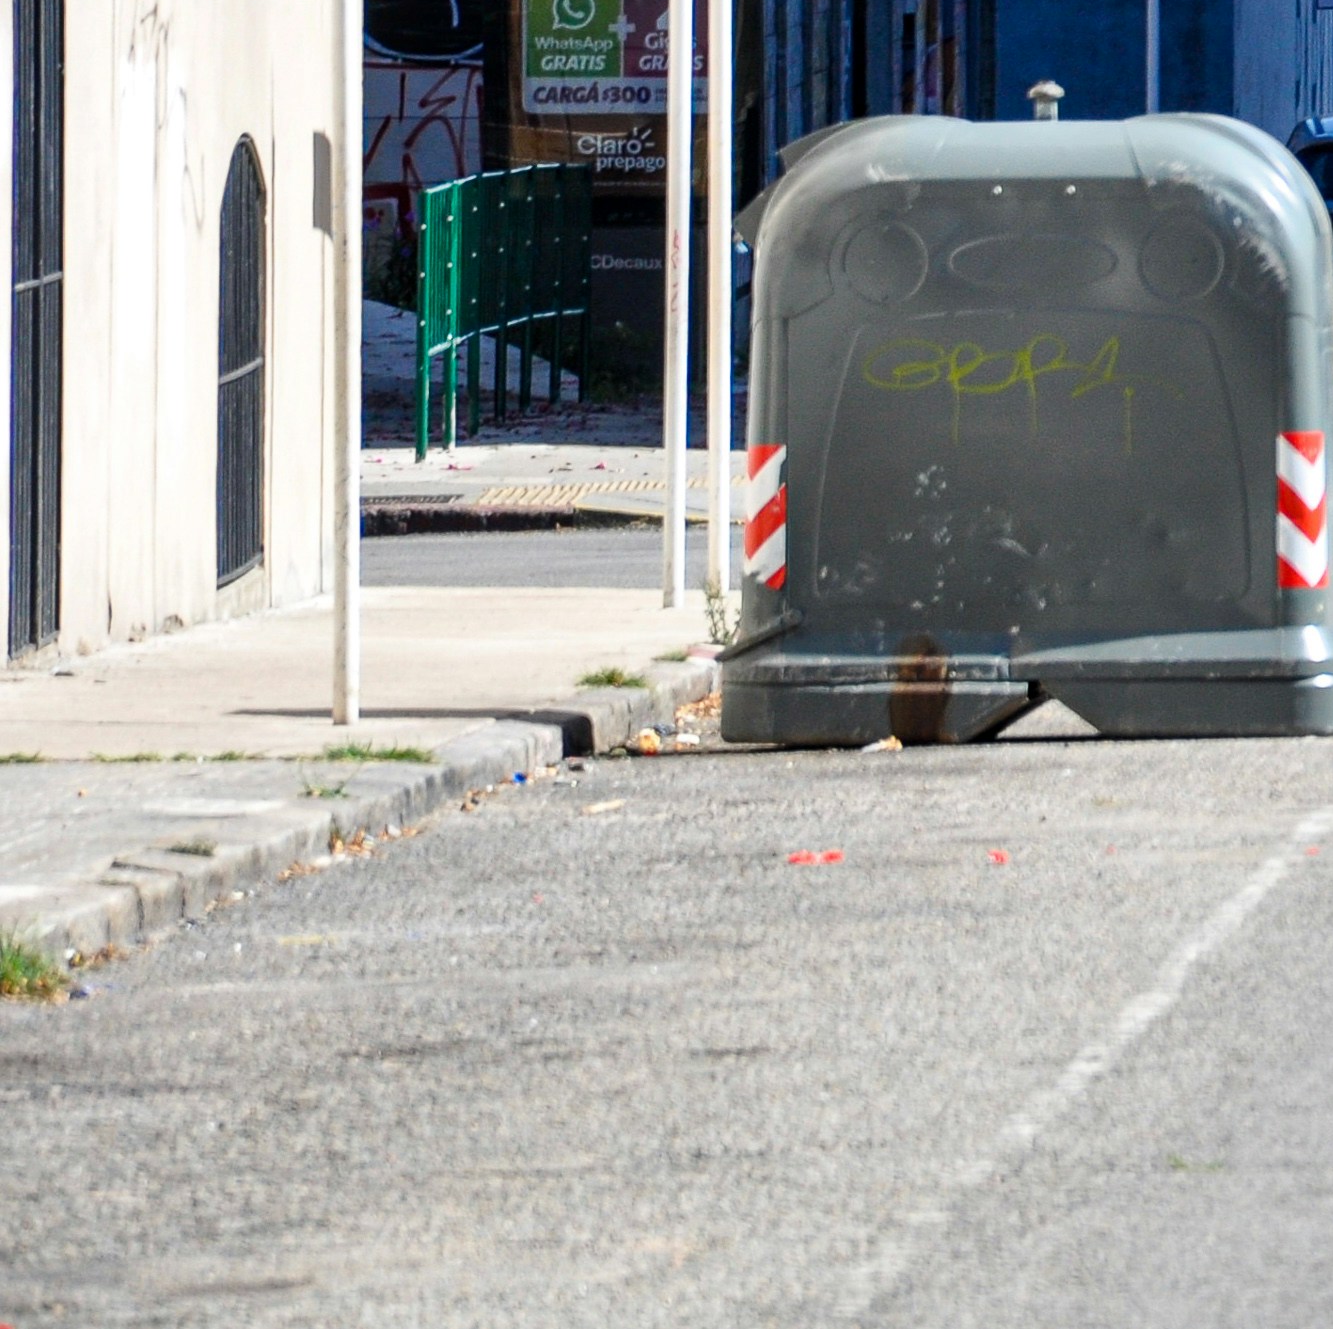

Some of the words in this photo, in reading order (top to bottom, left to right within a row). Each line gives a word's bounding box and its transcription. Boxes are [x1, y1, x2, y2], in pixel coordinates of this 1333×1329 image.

[535, 35, 613, 52] WhatsApp
[644, 32, 697, 51] Gis
[540, 54, 607, 71] GRATIS
[638, 54, 704, 71] GRS
[533, 82, 599, 104] CARGÁ
[577, 134, 643, 155] Claro
[596, 155, 666, 173] prepago
[590, 254, 663, 270] CDecaux
